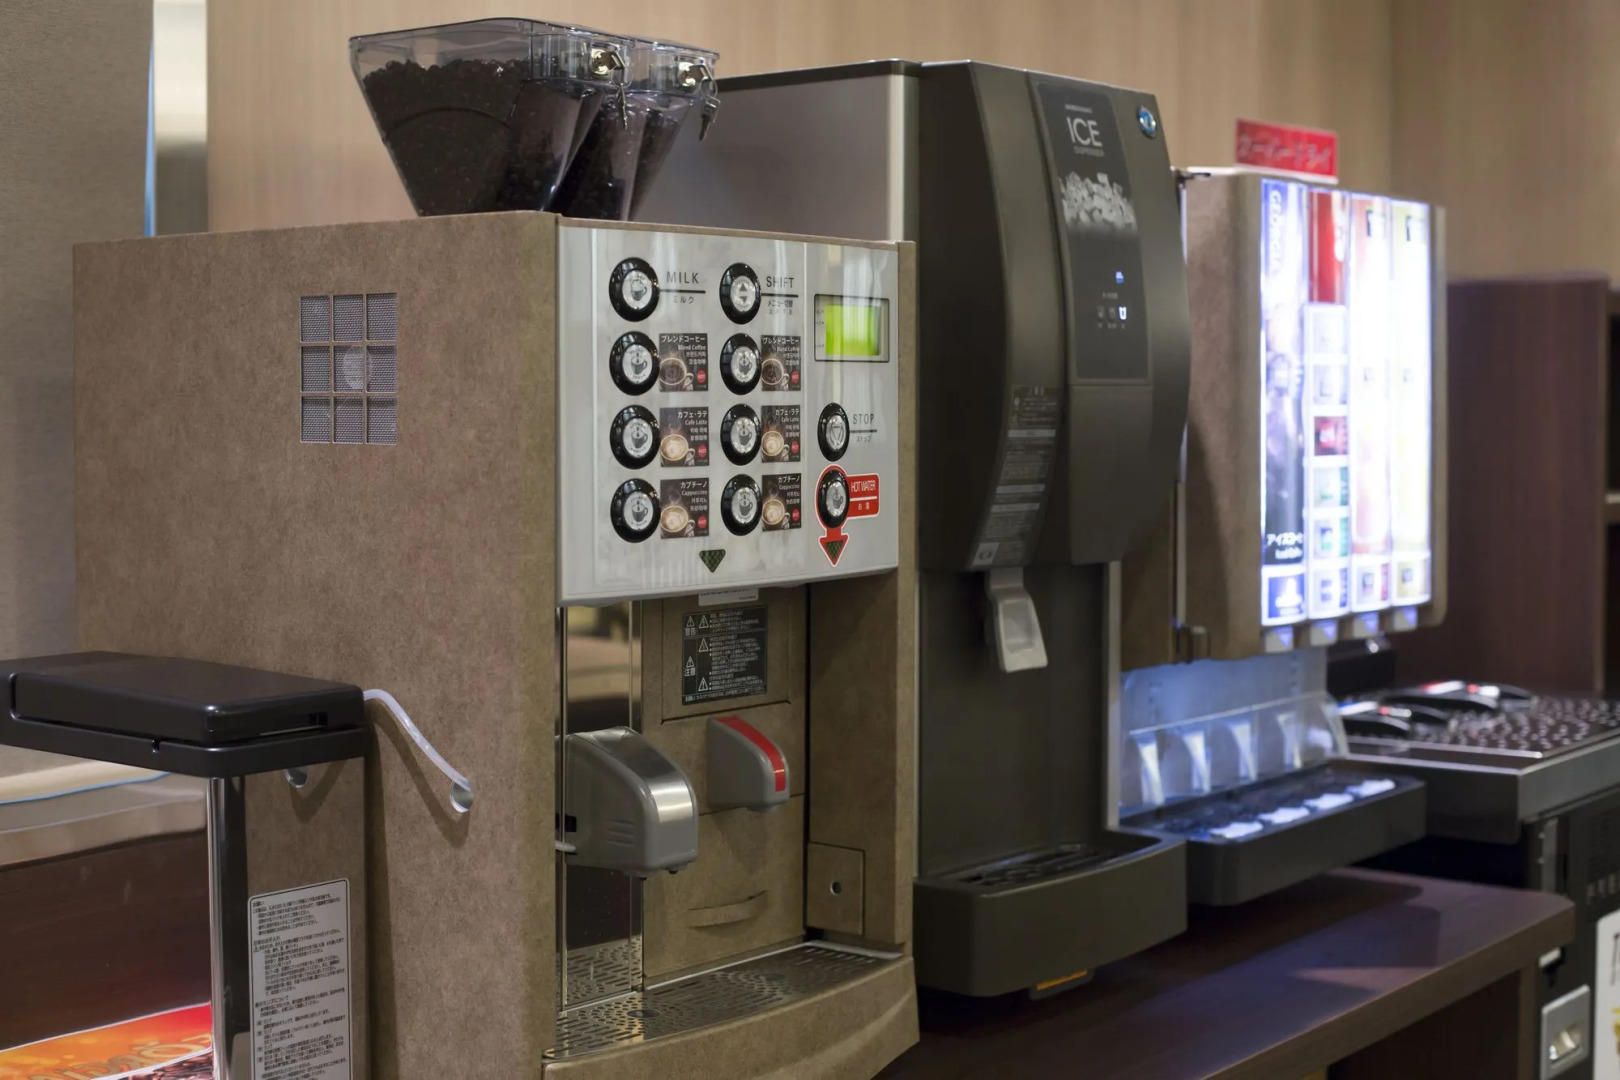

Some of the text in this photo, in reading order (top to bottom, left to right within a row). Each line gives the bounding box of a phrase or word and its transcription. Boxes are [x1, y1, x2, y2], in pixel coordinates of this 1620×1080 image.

[1066, 116, 1103, 147] ICE
[666, 271, 699, 284] MILK
[766, 275, 795, 289] SHIFT
[673, 295, 695, 304] ミルク
[661, 335, 706, 343] ブレンドコーヒー
[763, 336, 800, 345] ブレンドコーヒー
[853, 413, 874, 425] STOP
[680, 480, 708, 489] カプチーノ
[777, 475, 800, 484] カプチーノ
[851, 480, 876, 493] HOT WATER
